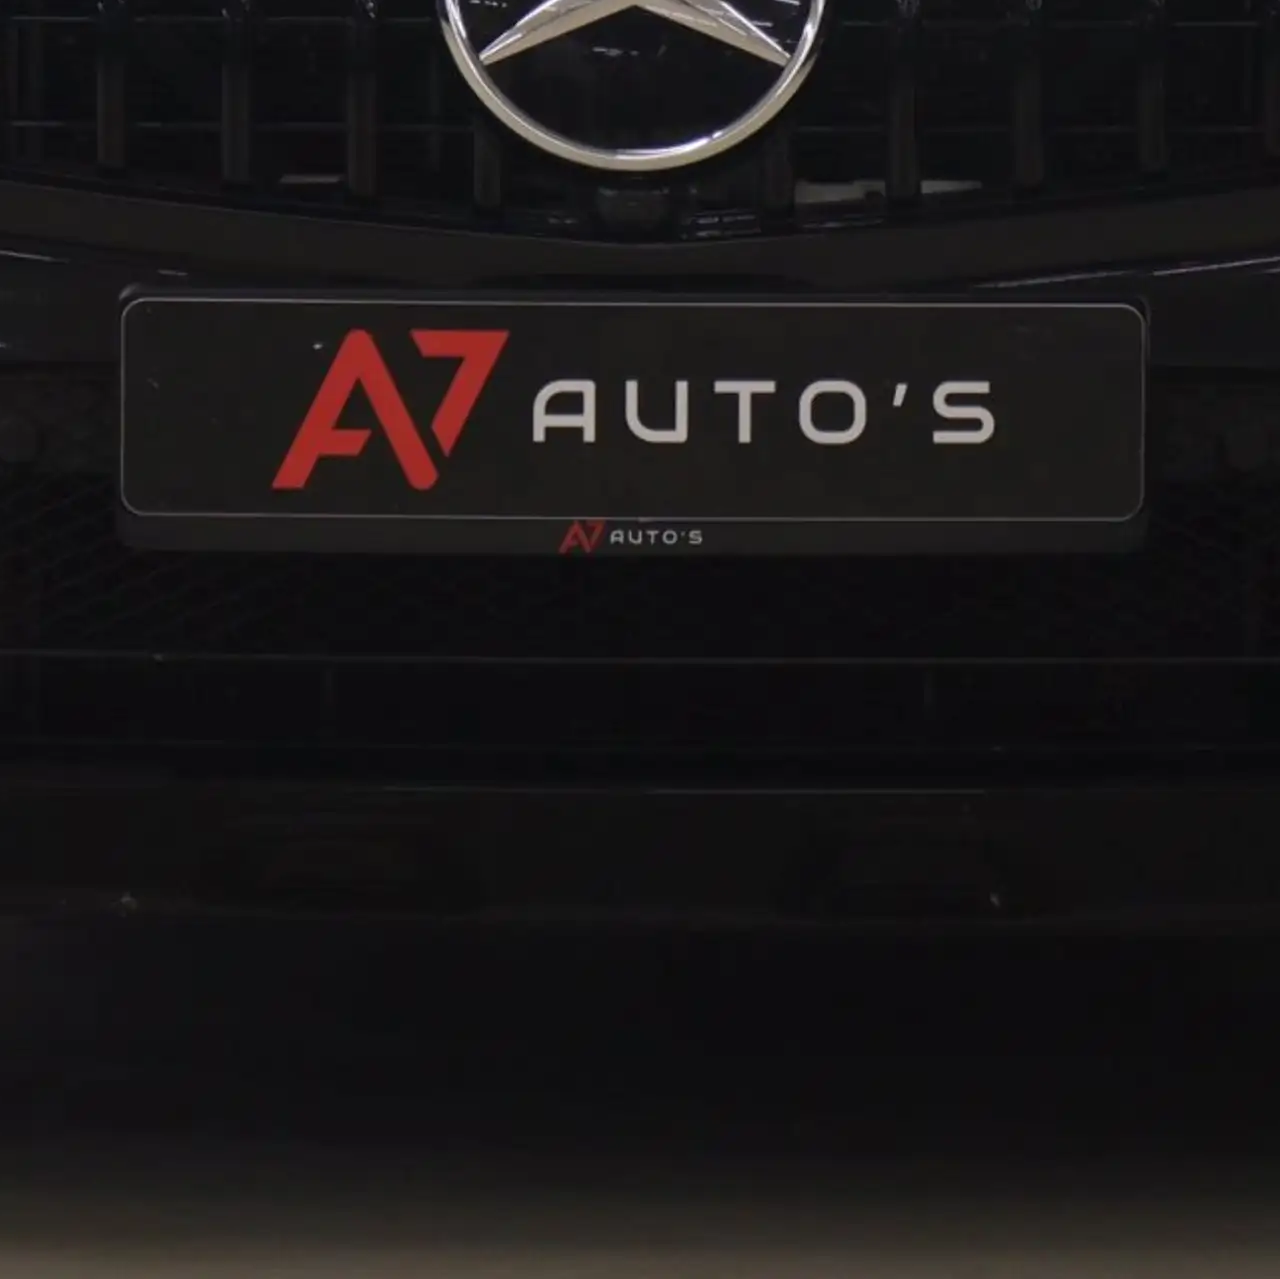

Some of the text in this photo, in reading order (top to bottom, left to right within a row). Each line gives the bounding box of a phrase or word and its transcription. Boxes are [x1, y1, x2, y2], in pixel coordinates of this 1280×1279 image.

[272, 328, 995, 490] A7 AUTO'S
[560, 520, 703, 554] A7 AUTO'S
